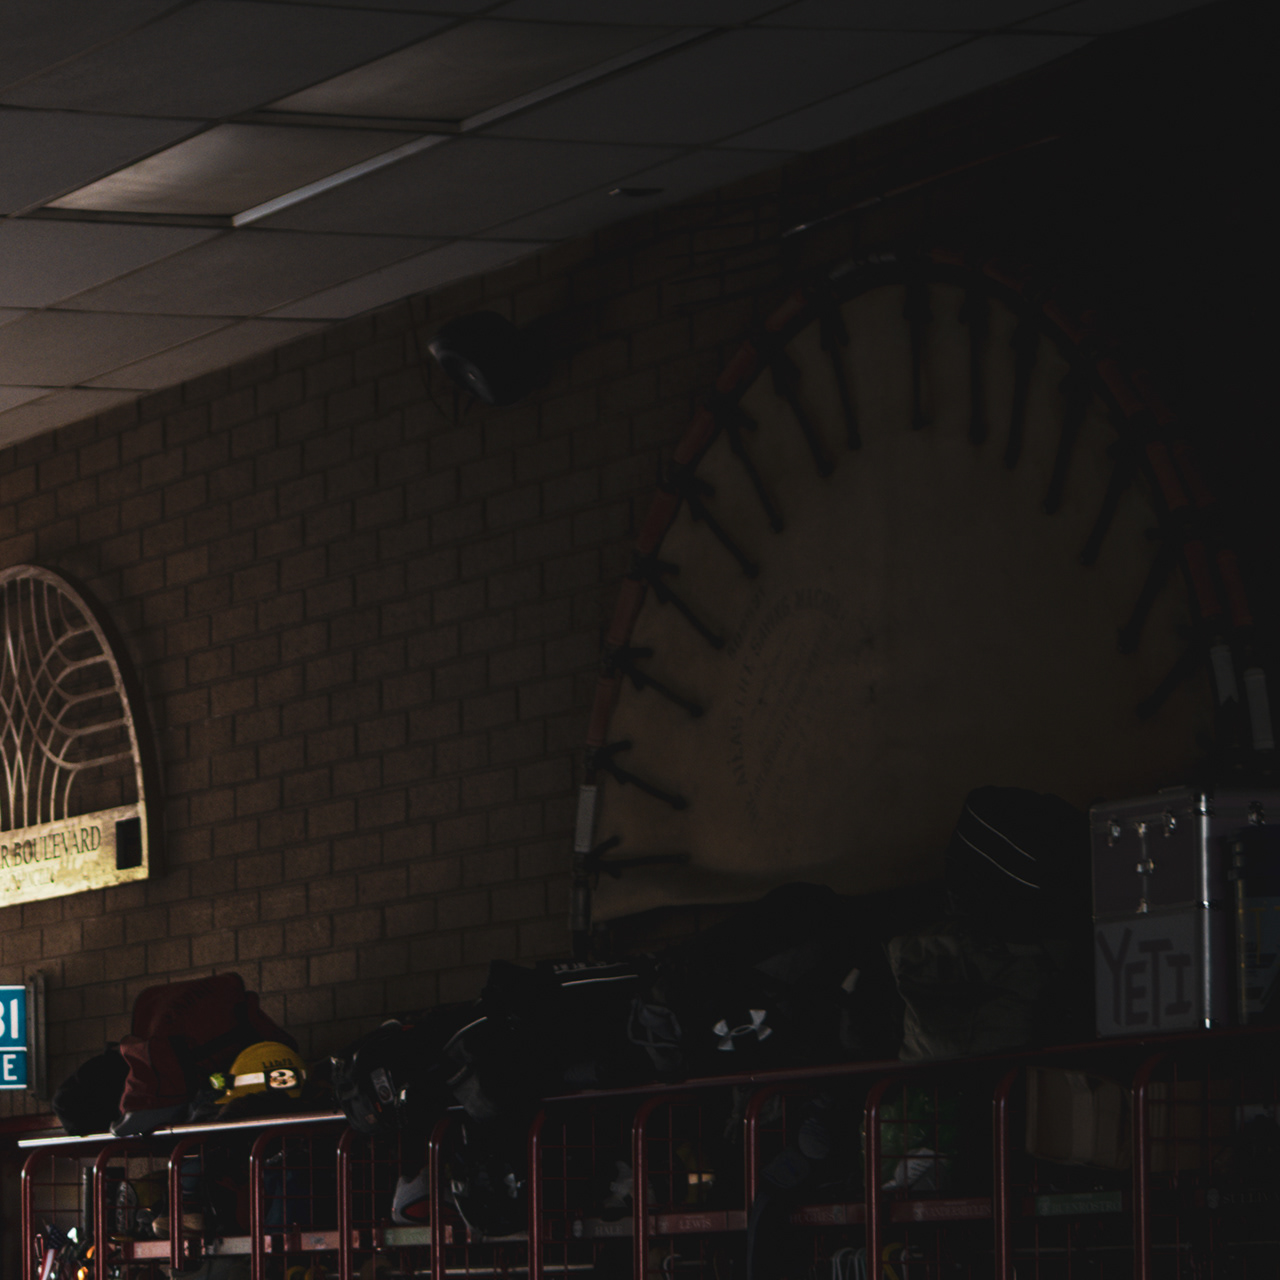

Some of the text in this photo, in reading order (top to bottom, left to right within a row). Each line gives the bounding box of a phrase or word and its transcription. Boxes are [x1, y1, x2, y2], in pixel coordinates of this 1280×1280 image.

[13, 825, 102, 867] BOULEVARD
[1096, 927, 1193, 1029] YETI
[2, 1054, 18, 1081] E
[593, 1225, 625, 1238] HALE
[678, 1218, 713, 1230] LEWIS
